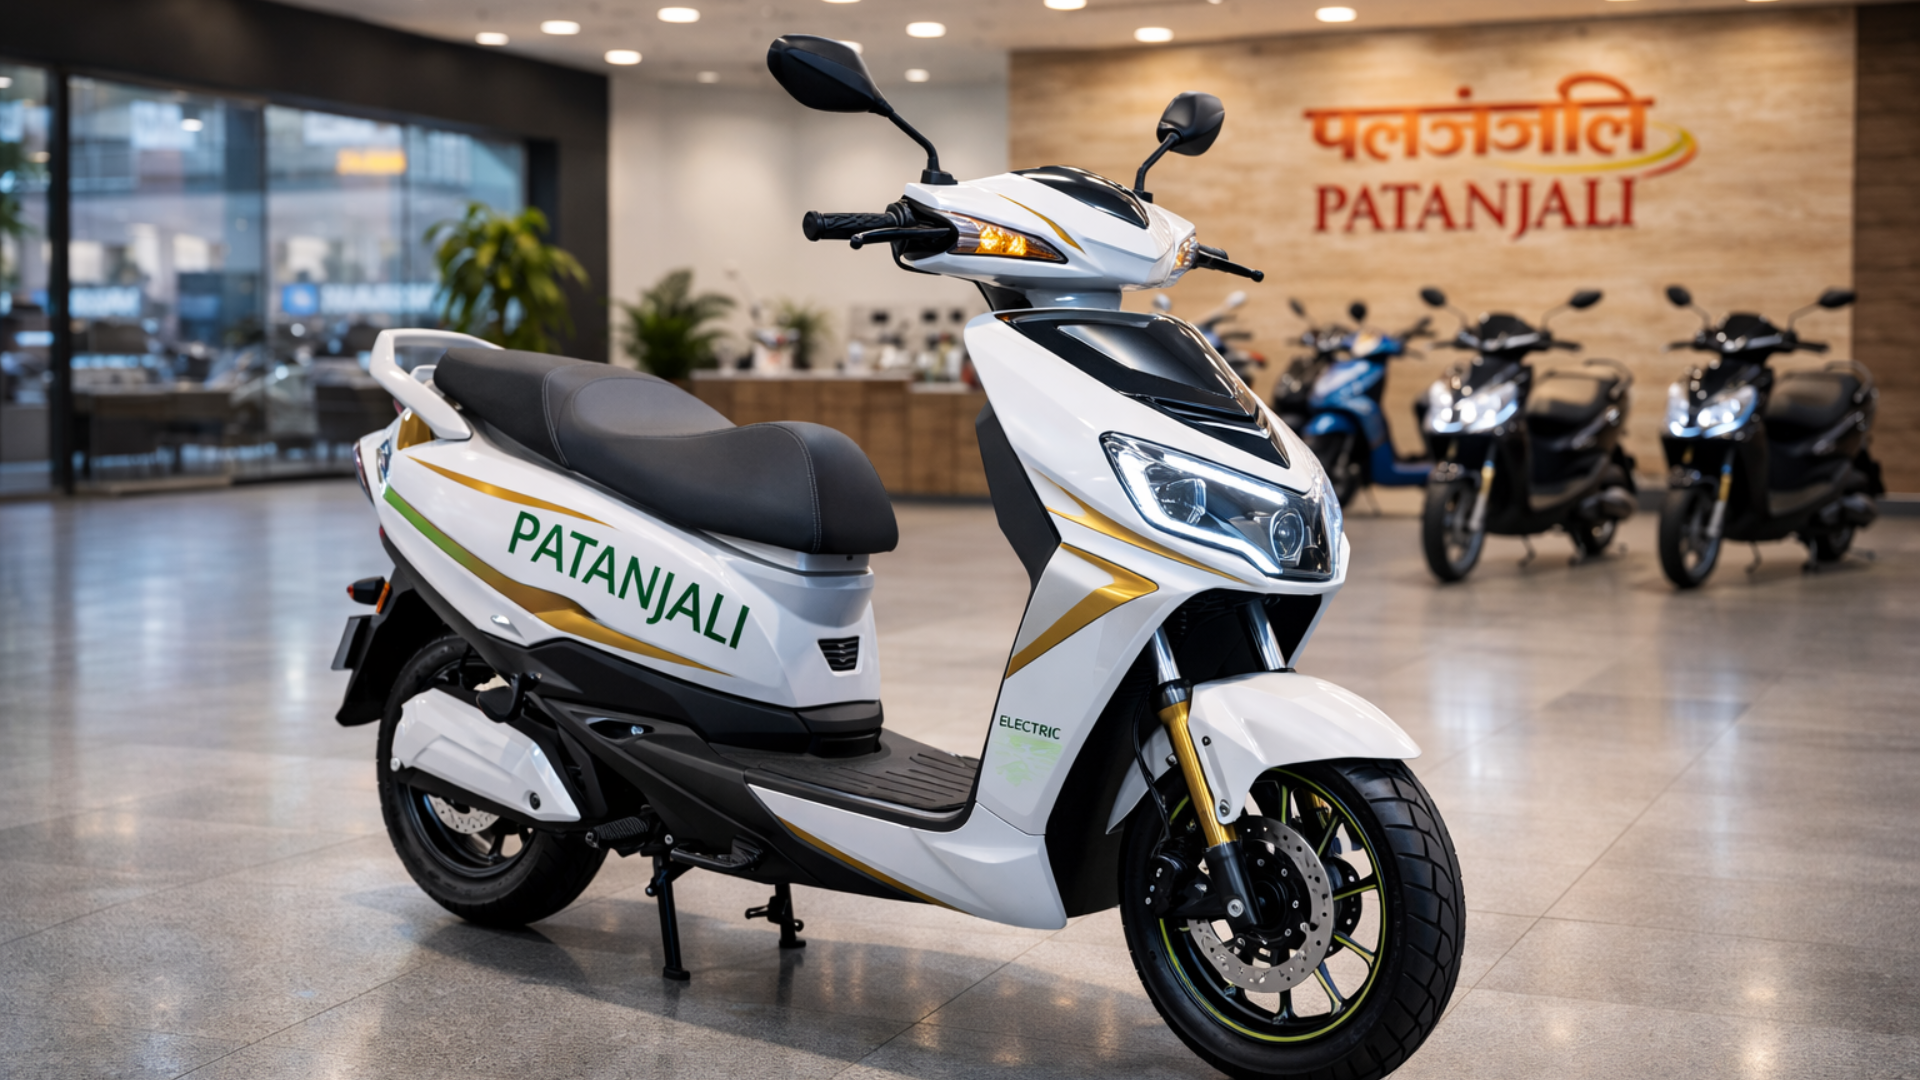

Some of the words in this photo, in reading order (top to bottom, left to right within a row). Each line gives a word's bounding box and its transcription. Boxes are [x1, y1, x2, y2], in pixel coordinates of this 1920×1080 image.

[1313, 178, 1637, 240] PATANJALI
[508, 510, 750, 650] PATANJALI
[999, 714, 1061, 740] ELECTRIC
